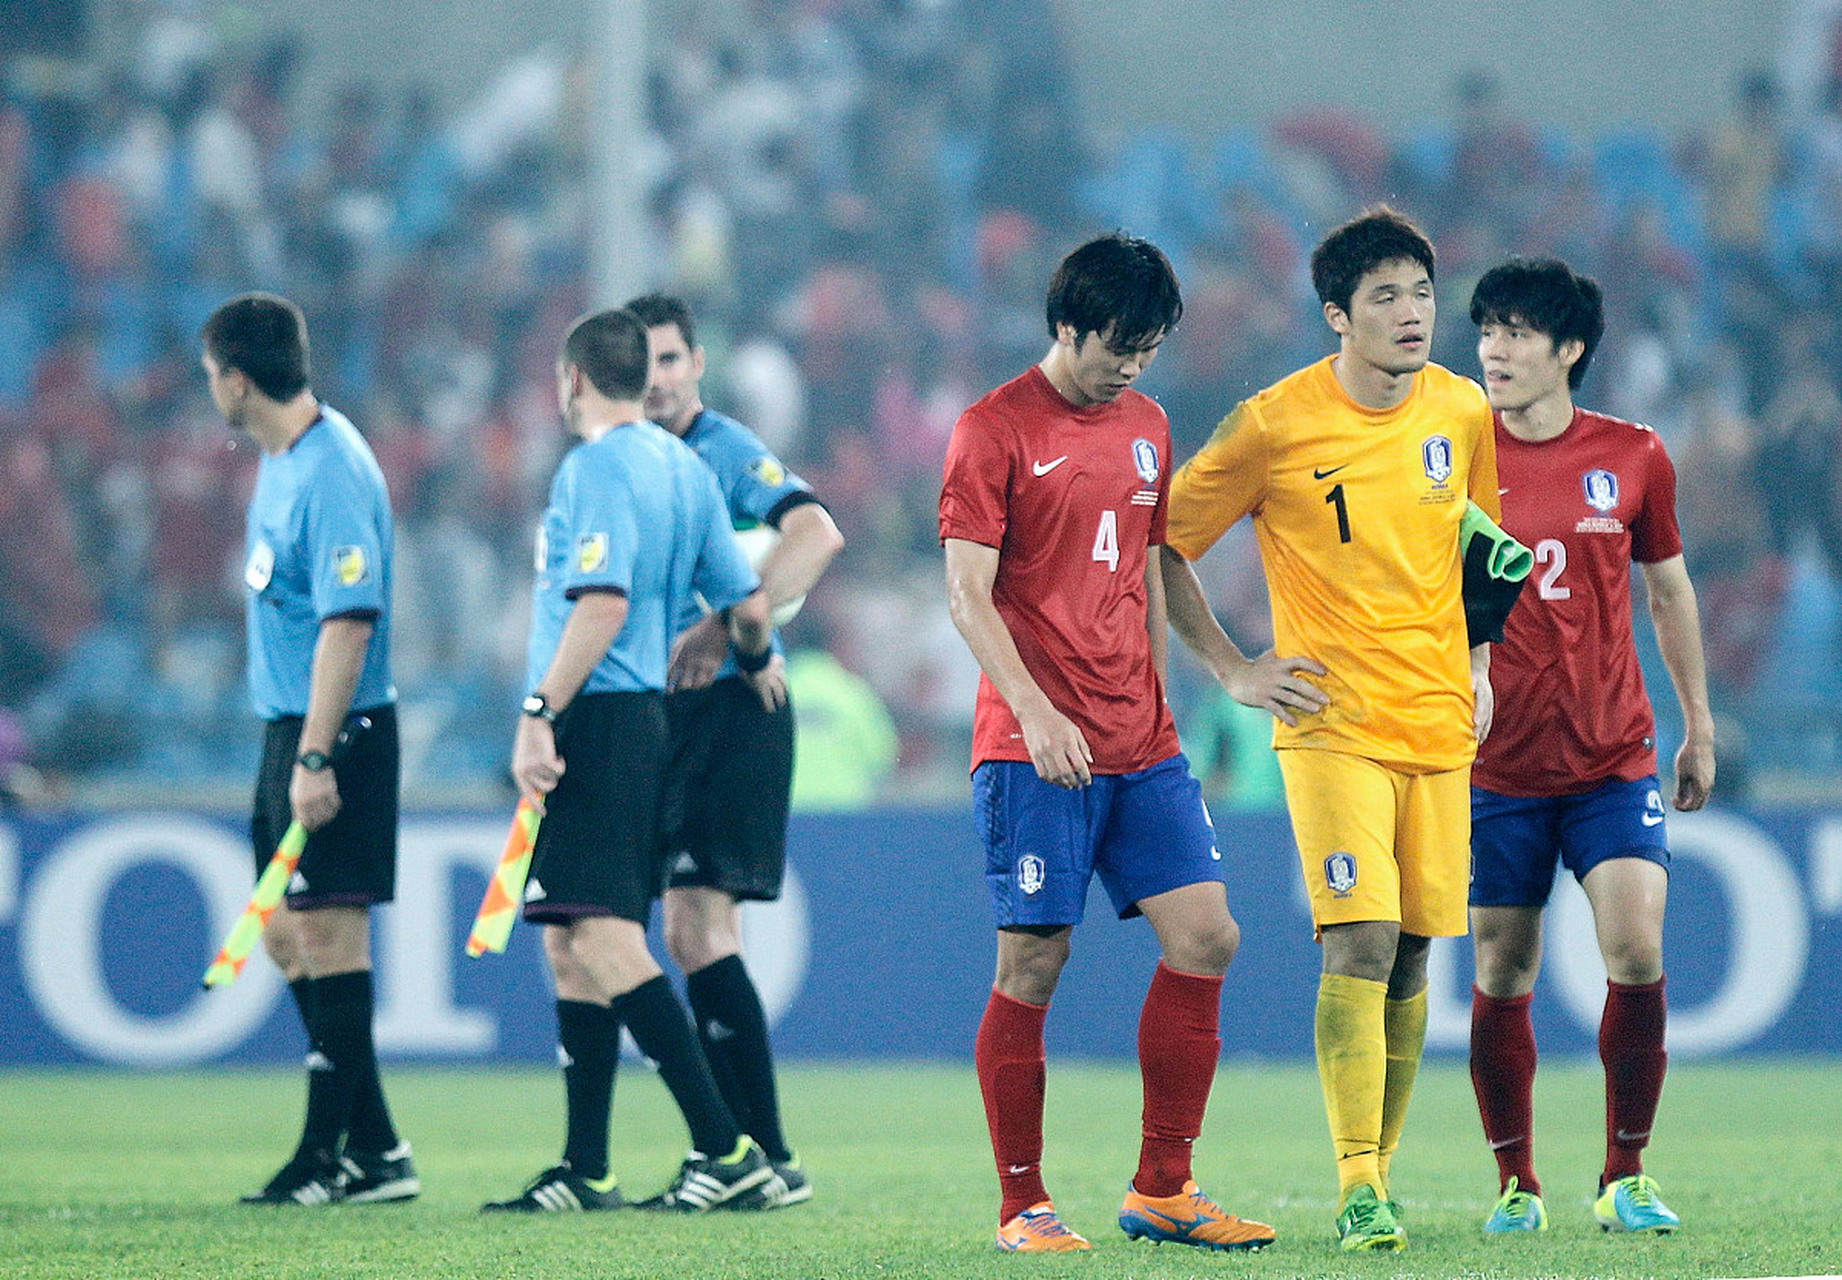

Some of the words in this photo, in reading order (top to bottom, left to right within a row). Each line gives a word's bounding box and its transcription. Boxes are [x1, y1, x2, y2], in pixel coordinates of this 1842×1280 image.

[1092, 510, 1120, 572] 4
[1326, 483, 1351, 543] 1
[1536, 538, 1571, 600] 2
